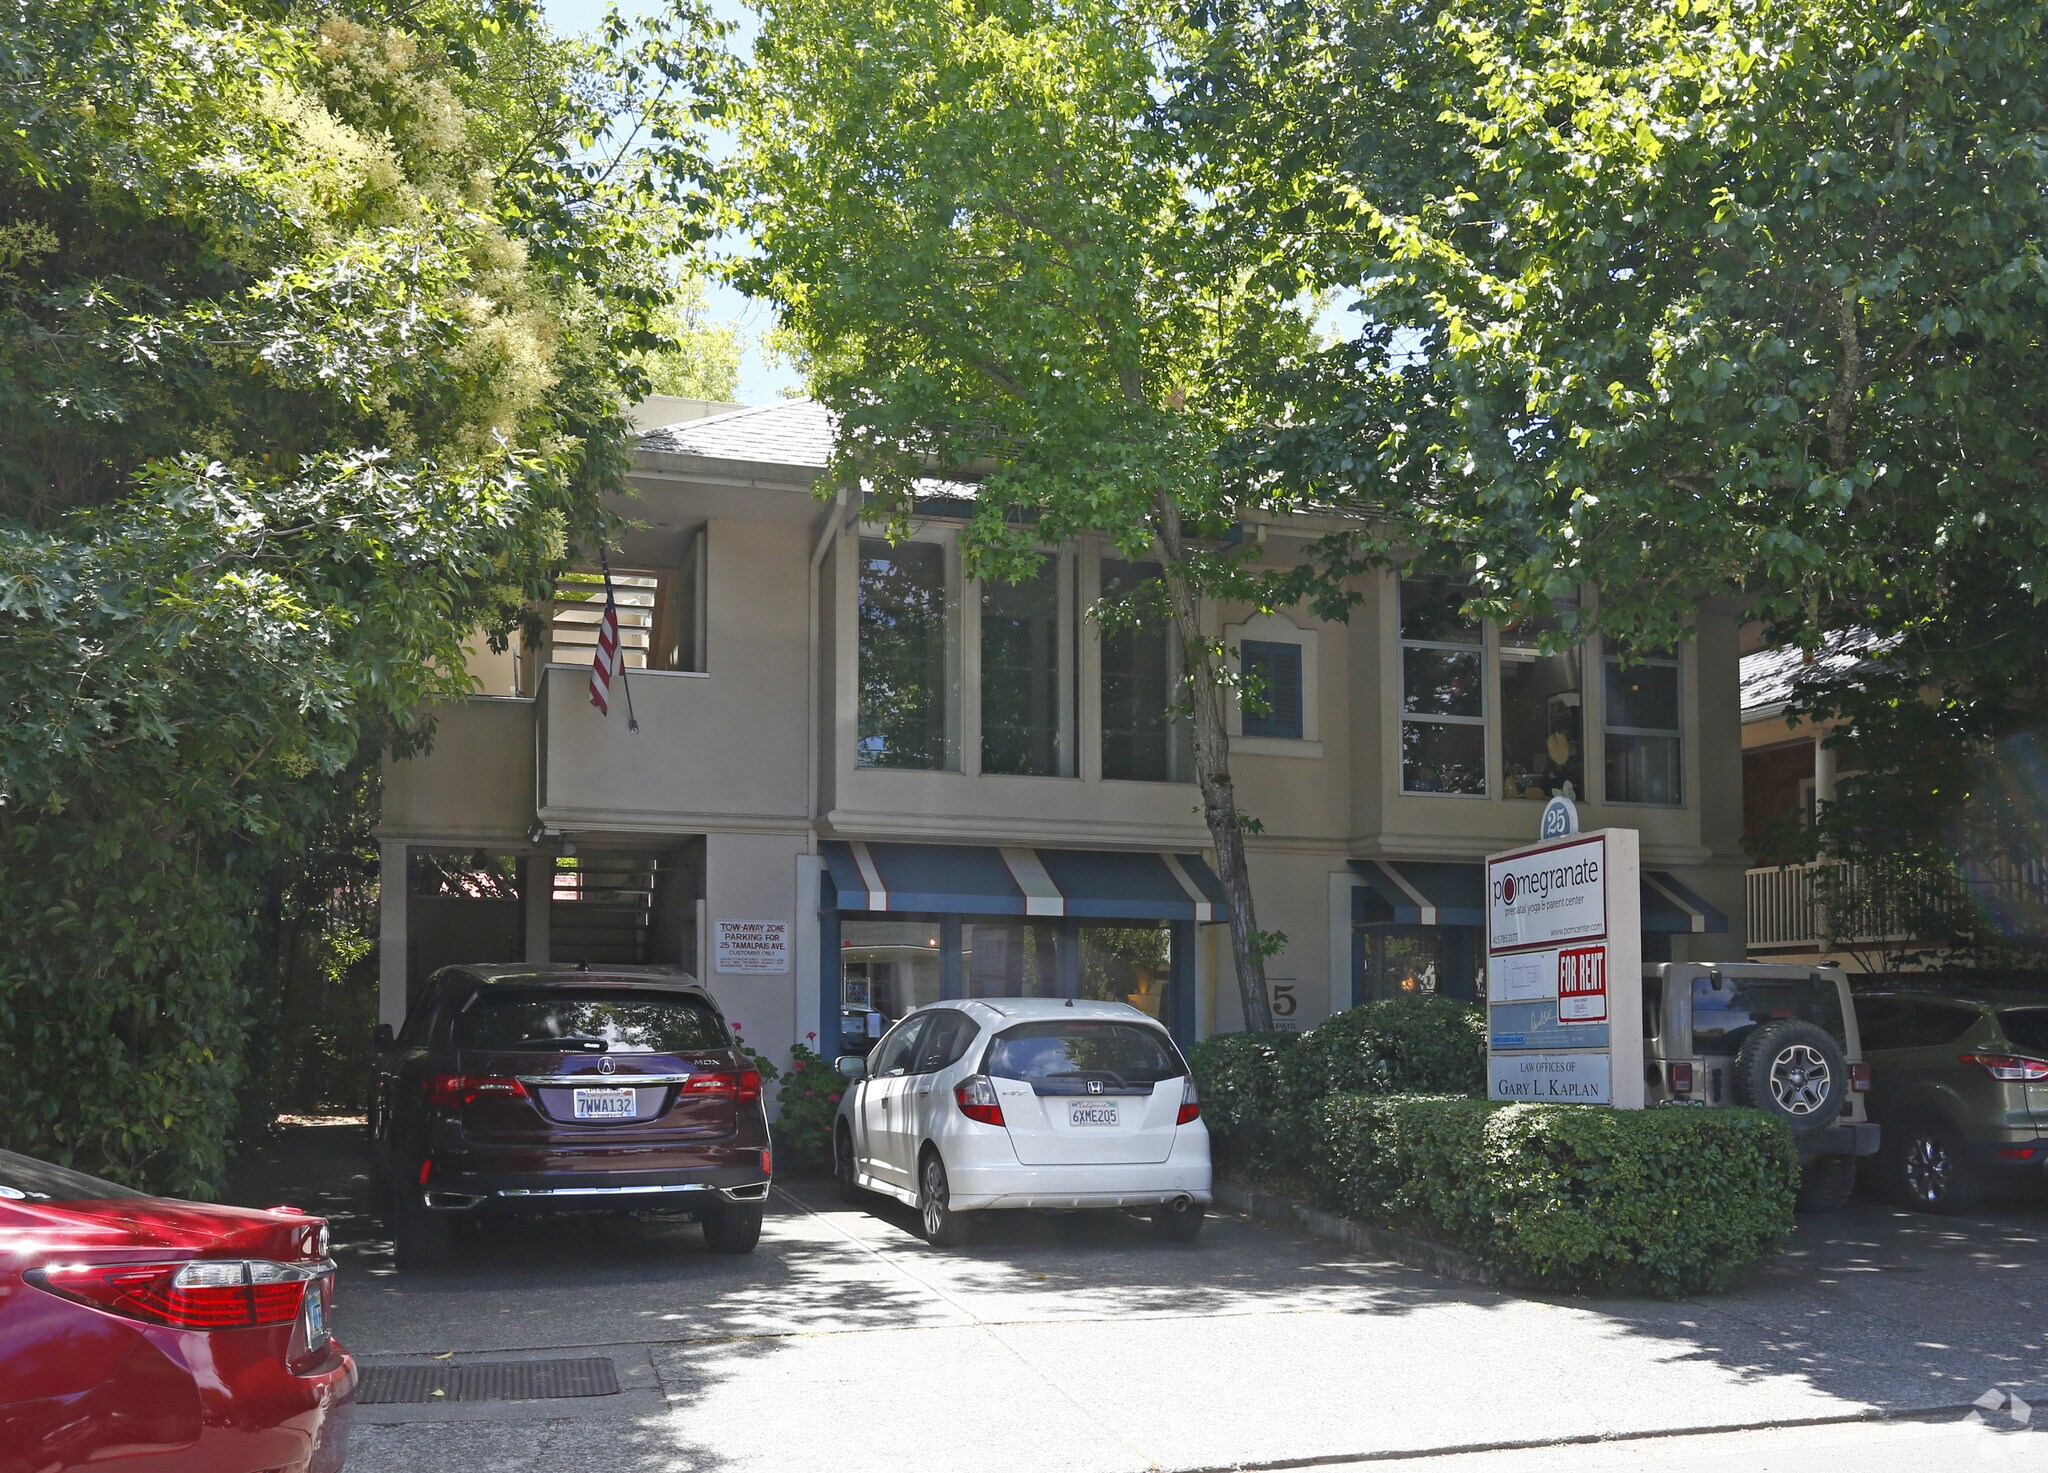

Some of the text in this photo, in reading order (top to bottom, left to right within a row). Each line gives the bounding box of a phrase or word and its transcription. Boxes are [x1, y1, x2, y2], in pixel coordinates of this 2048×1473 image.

[1547, 807, 1566, 835] 25
[1493, 858, 1598, 907] pomegranate
[1504, 903, 1527, 918] prenatal
[1527, 902, 1541, 916] yoga
[1546, 897, 1565, 913] parent
[1565, 895, 1584, 907] center
[720, 923, 764, 932] TOW-AWAY
[1550, 923, 1603, 937] www.pomcenter.com
[724, 933, 762, 941] PARKING
[1560, 952, 1603, 993] FOR RENT
[1520, 1062, 1576, 1073] LAW OFFICES OF
[1498, 1079, 1599, 1097] GARY L. KAPLAN
[578, 1099, 631, 1112] 7WWA132
[1073, 1109, 1117, 1122] 6XME205
